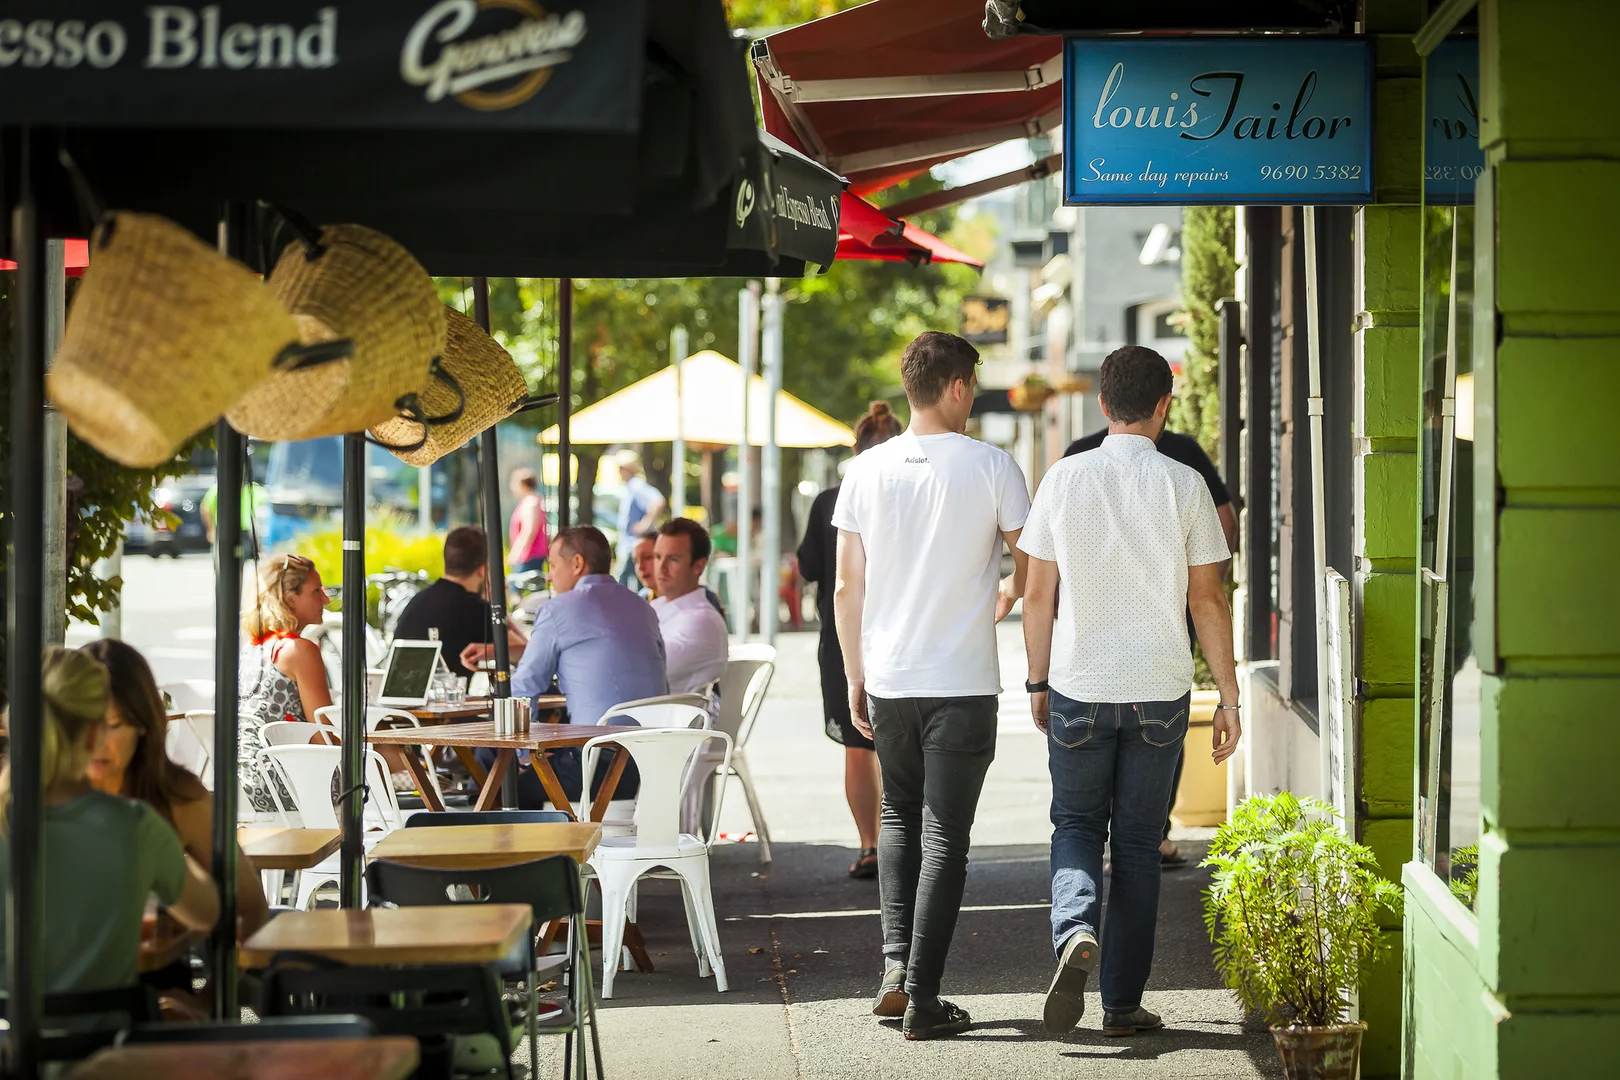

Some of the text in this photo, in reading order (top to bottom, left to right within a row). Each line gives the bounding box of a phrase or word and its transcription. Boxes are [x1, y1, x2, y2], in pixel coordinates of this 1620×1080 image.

[144, 4, 339, 69] Blend
[1092, 61, 1351, 141] louis Tailor
[1081, 157, 1362, 188] Same day repairs 9690 5382
[806, 195, 832, 230] Blend
